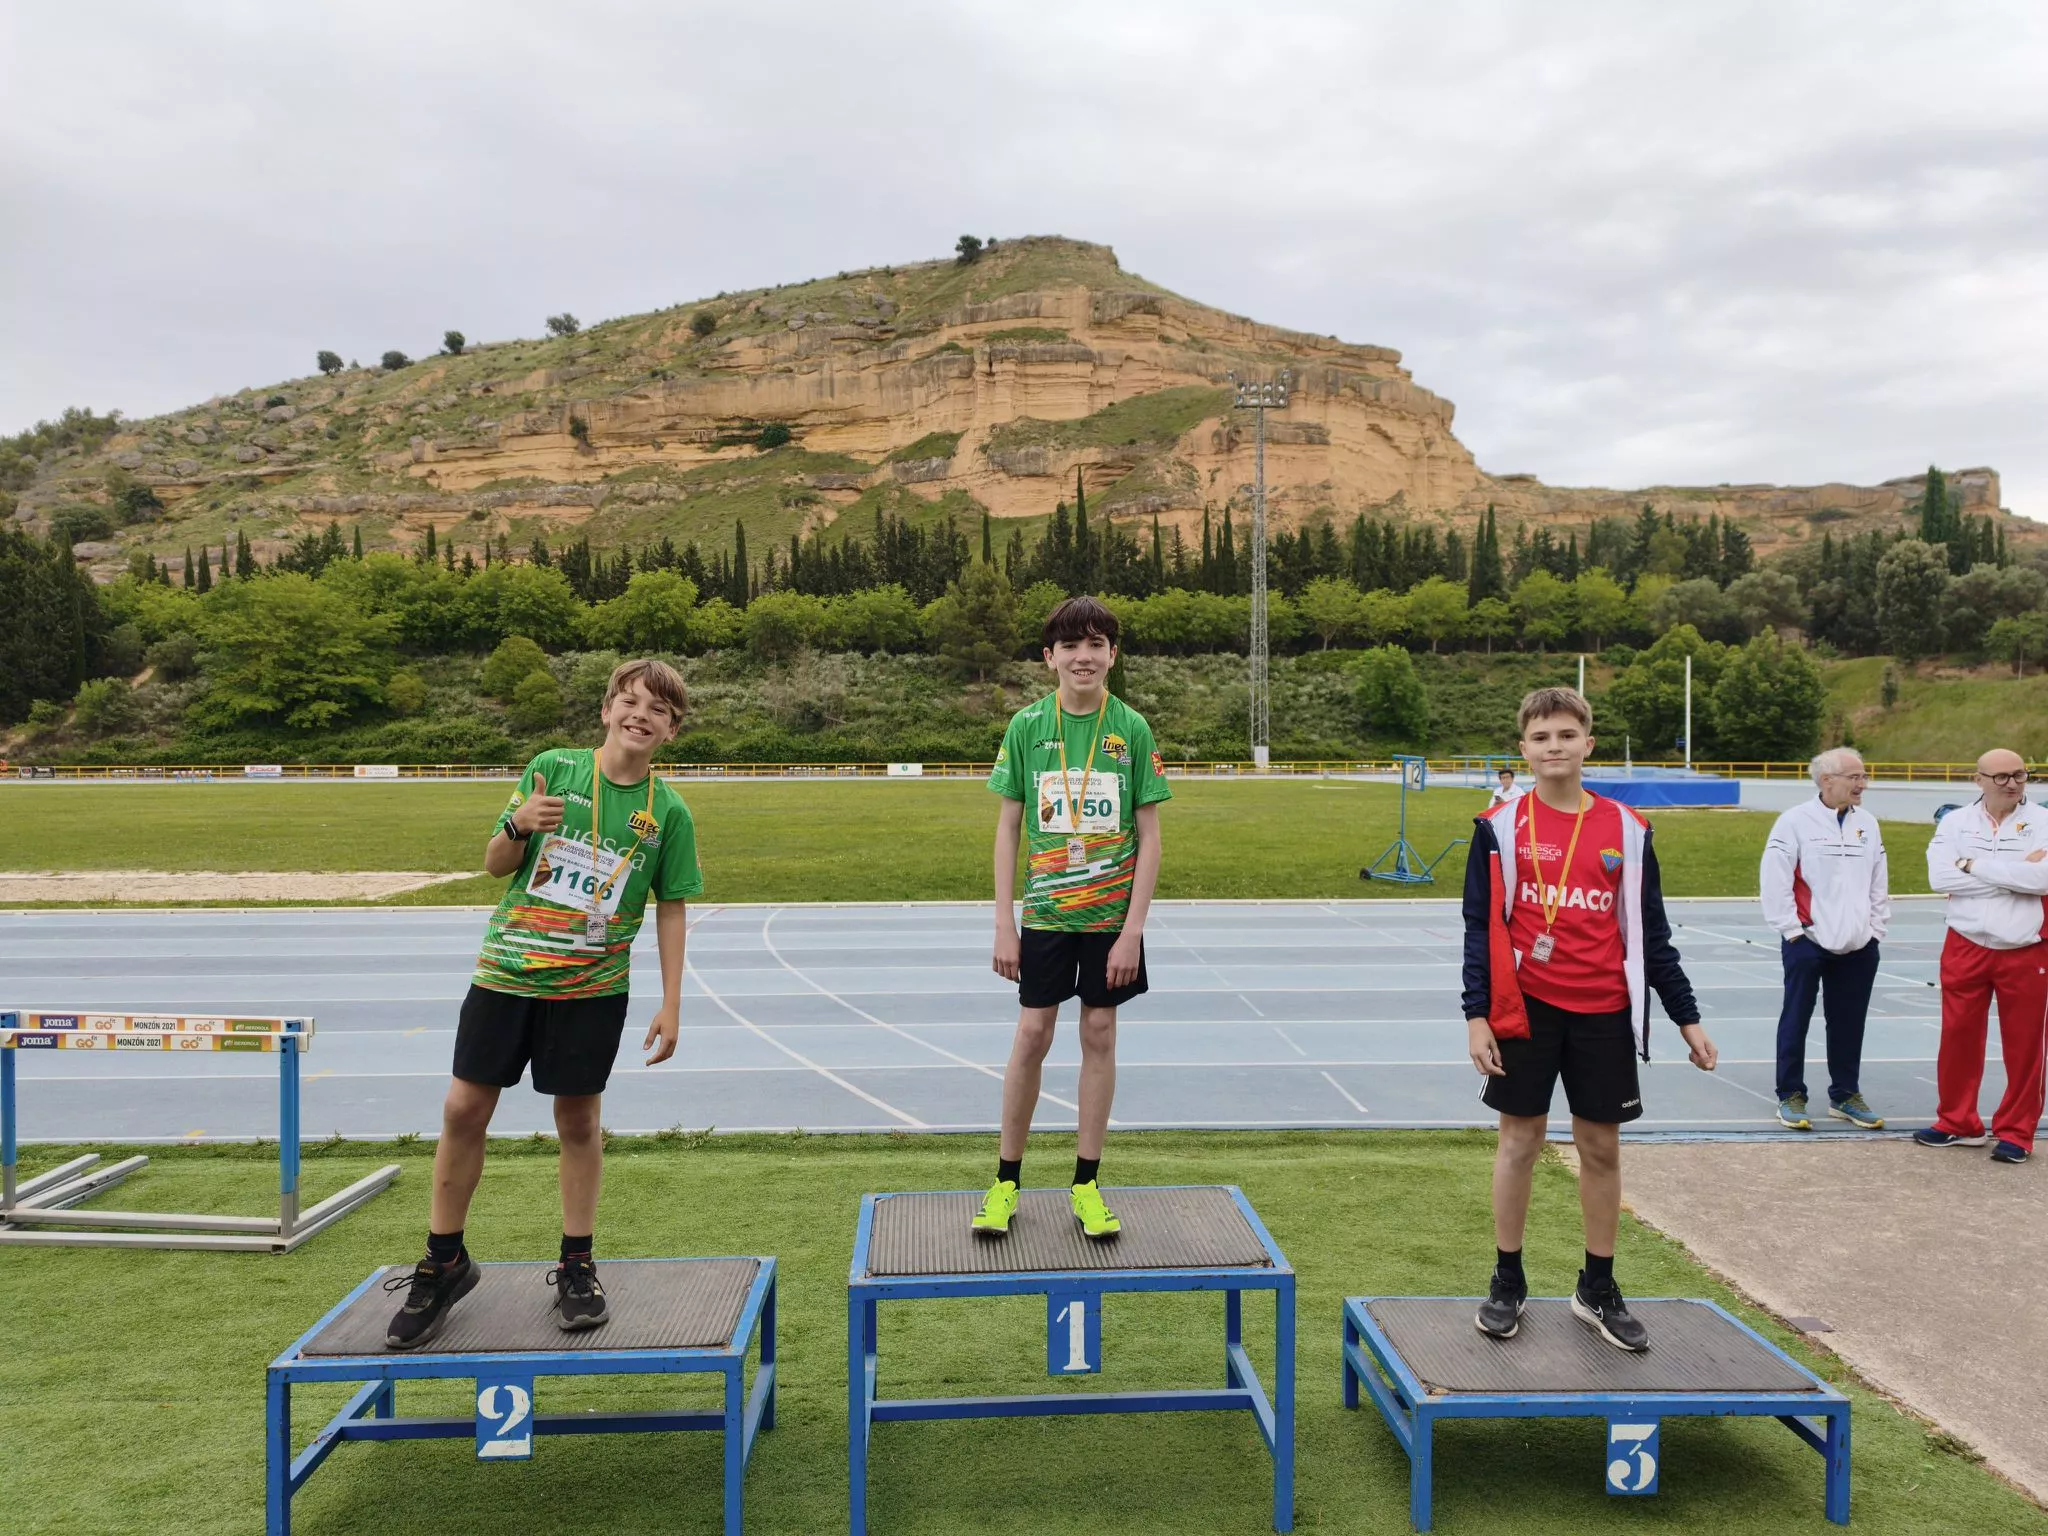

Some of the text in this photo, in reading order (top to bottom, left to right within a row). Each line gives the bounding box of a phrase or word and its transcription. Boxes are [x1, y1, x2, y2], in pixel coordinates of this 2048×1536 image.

[1414, 765, 1421, 783] 2
[551, 865, 615, 900] 1166
[95, 1020, 112, 1030] GO
[133, 1020, 176, 1031] MONZÓN 2021
[194, 1023, 212, 1031] GO
[75, 1038, 94, 1048] GO
[117, 1036, 161, 1047] MONZÓN 2021
[180, 1039, 199, 1049] GO
[1056, 1301, 1091, 1370] 1
[478, 1385, 531, 1457] 2
[1607, 1424, 1658, 1491] 3
